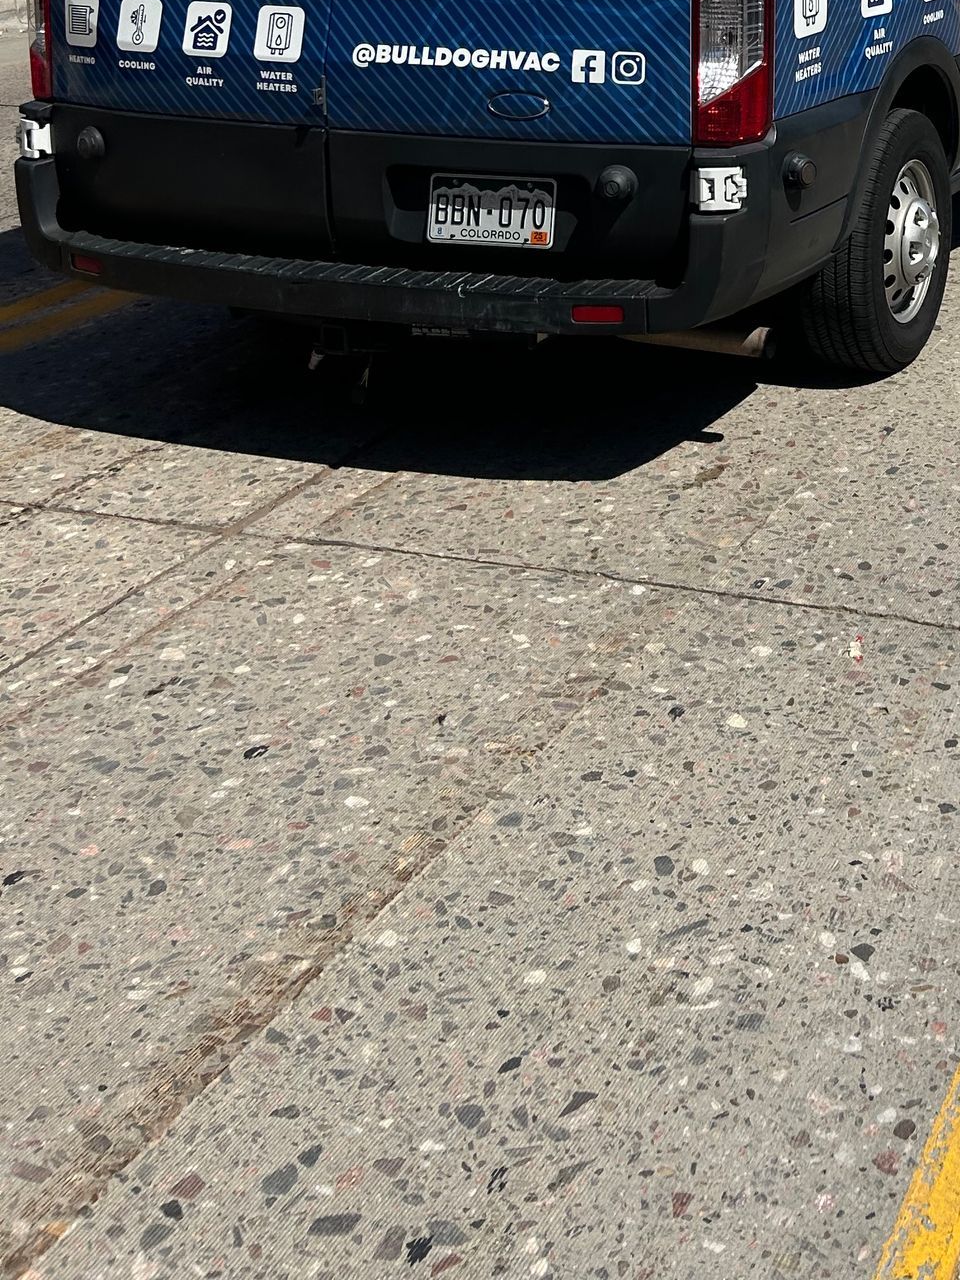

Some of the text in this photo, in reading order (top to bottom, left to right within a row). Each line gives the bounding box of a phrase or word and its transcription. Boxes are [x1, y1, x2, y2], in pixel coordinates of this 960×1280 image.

[873, 27, 886, 41] AIR
[798, 46, 821, 65] WATER
[864, 41, 894, 60] QUALITY
[68, 54, 96, 65] HEATING
[352, 43, 561, 73] @BULLDOGHVAC
[118, 59, 156, 71] COOLING
[196, 66, 213, 75] AIR
[260, 70, 293, 81] WATER
[795, 62, 822, 83] HEATERS
[185, 77, 224, 87] QUALITY
[256, 82, 298, 93] HEATERS
[460, 228, 521, 241] COLORADO
